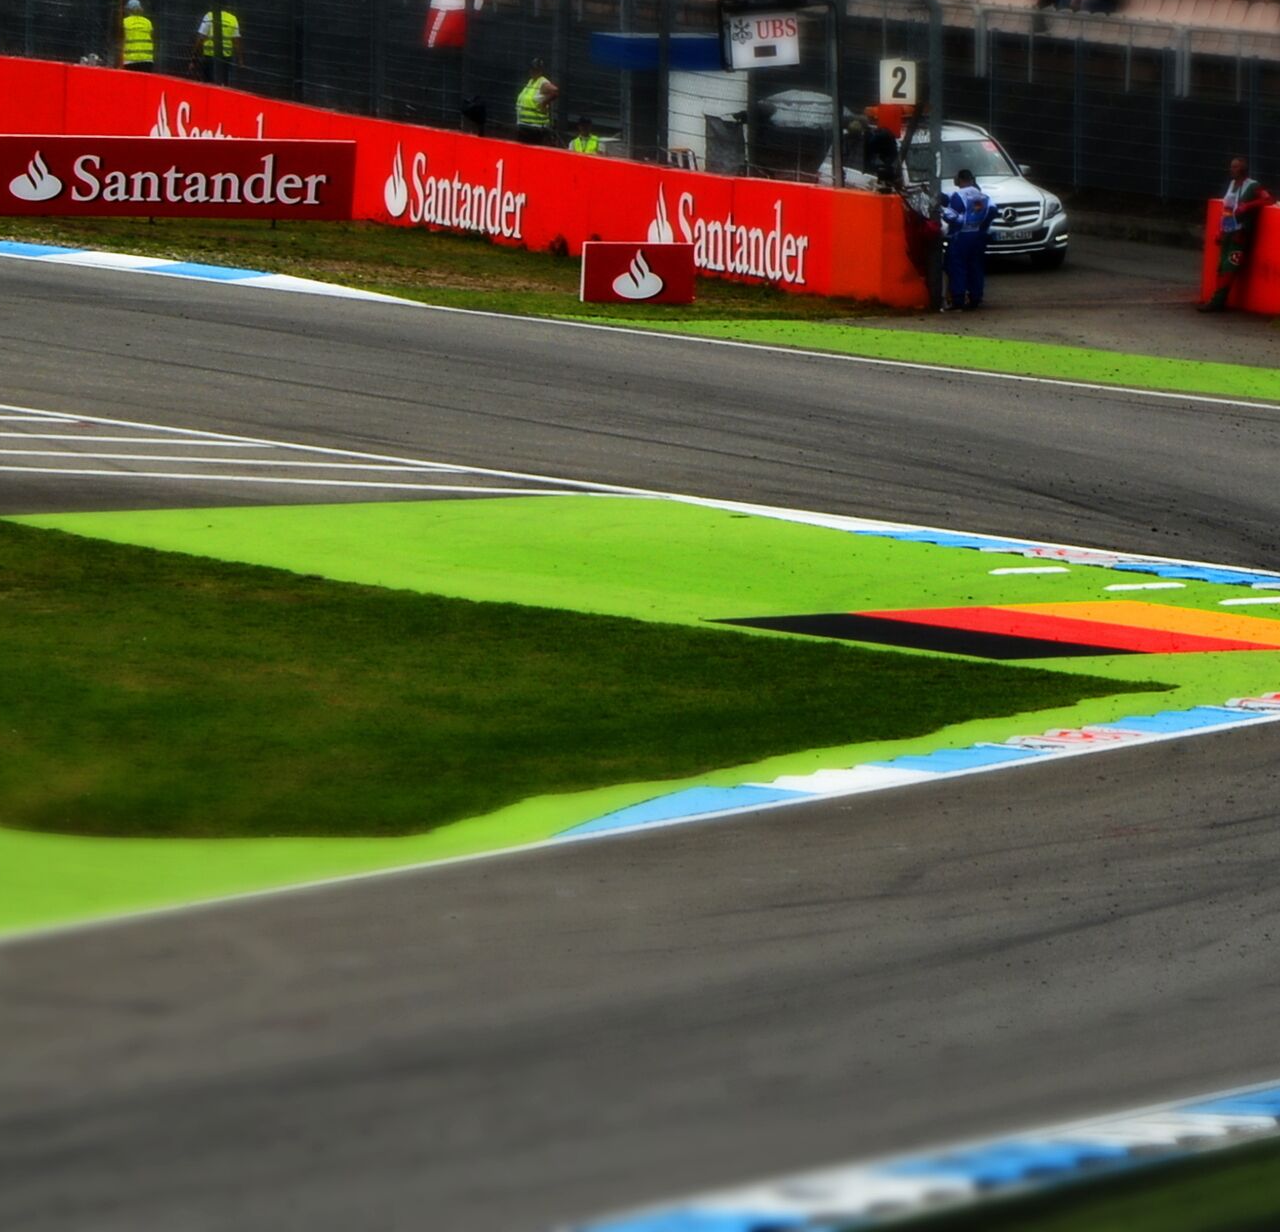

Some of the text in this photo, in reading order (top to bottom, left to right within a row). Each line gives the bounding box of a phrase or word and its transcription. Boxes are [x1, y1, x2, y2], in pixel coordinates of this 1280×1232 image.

[756, 18, 797, 39] UBS
[891, 66, 907, 99] 2
[71, 154, 326, 204] Santander
[410, 151, 526, 238] Santander
[678, 191, 808, 284] Santander
